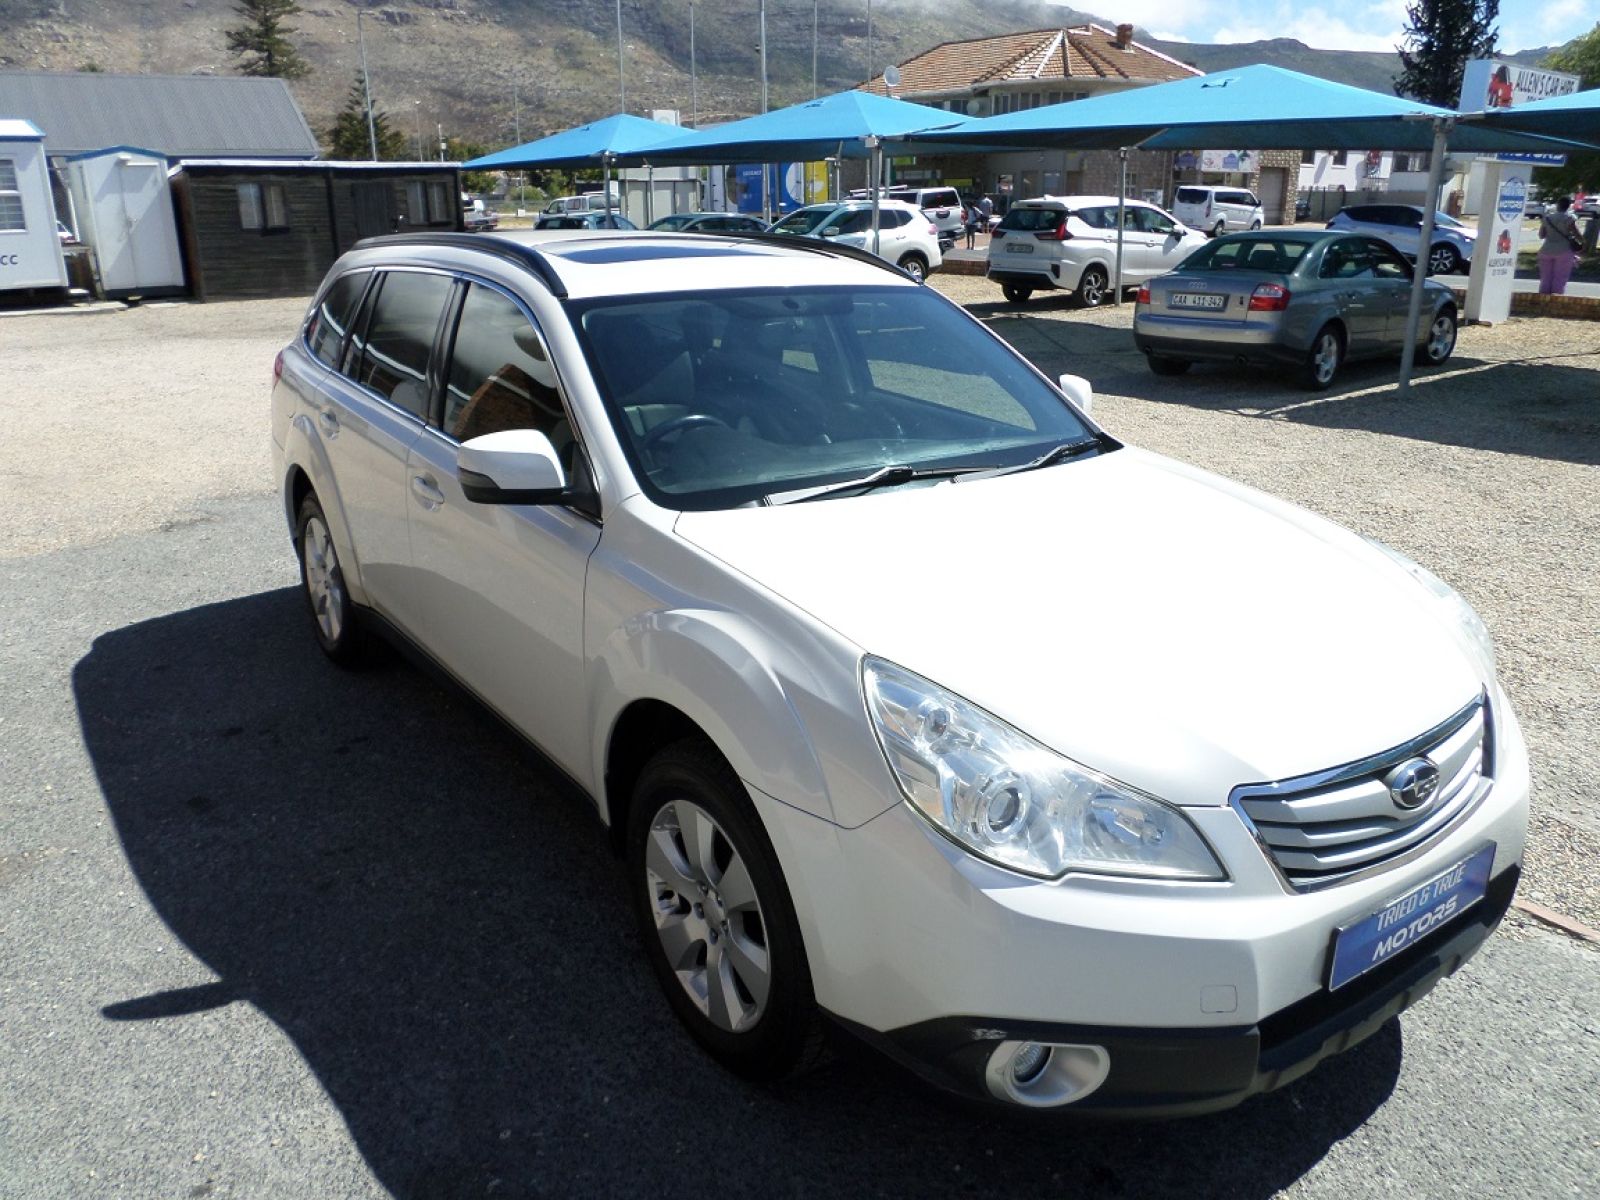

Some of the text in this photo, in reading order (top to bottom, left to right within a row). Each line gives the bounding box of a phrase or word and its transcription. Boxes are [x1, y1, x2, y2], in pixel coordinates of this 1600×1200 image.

[1372, 896, 1458, 961] MOTORS
[1377, 865, 1465, 931] TRIED & TRUE
